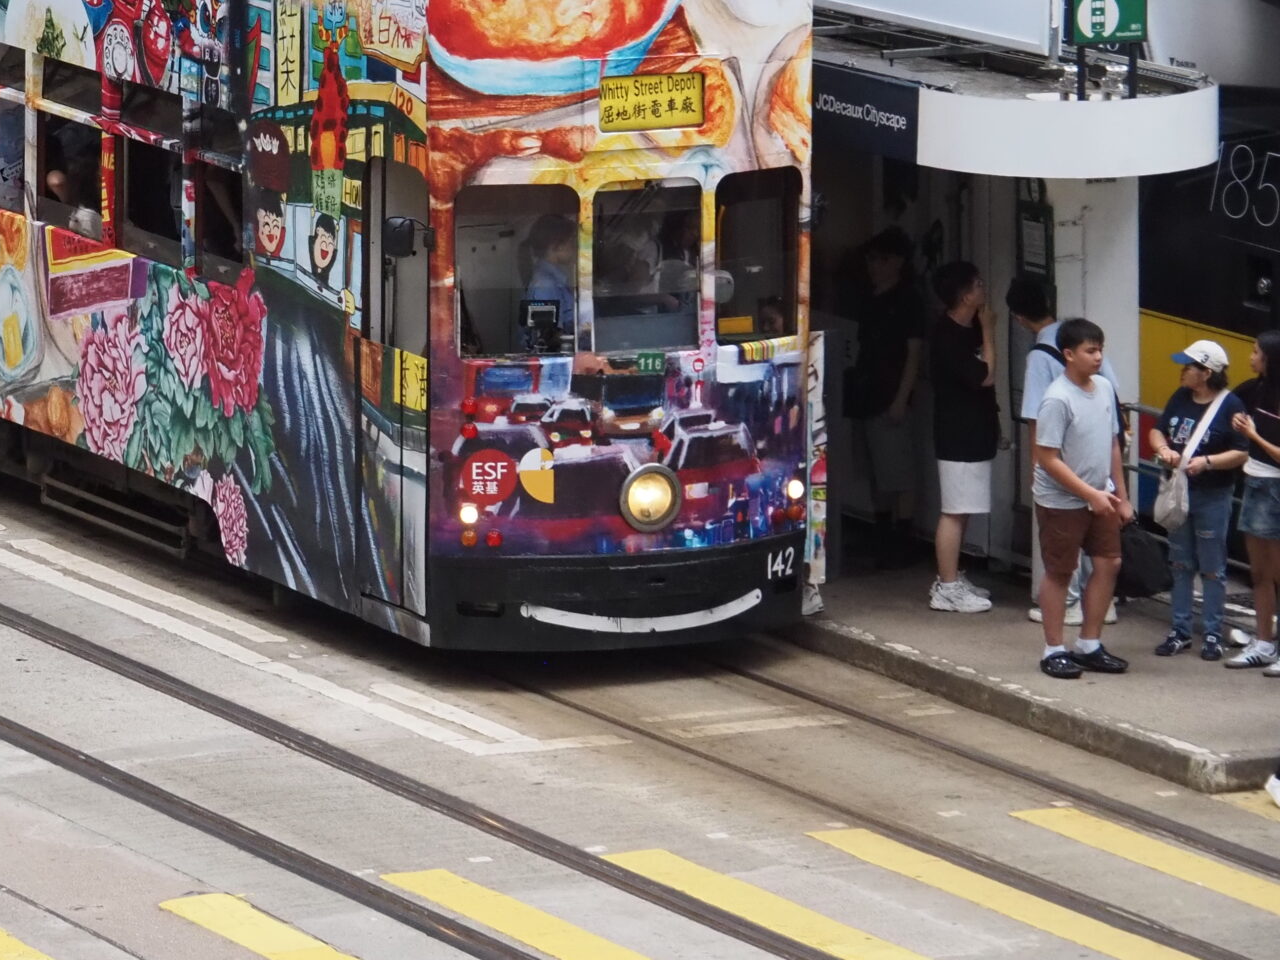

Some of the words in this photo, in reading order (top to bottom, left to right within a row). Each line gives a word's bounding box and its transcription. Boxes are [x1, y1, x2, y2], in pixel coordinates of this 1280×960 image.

[600, 83, 629, 102] Whitty
[633, 79, 663, 97] Street
[667, 74, 696, 94] Depot
[395, 92, 414, 116] 120
[600, 96, 697, 125] 屈地街電車廠
[816, 93, 863, 120] JCDecaux
[863, 103, 907, 131] Cityscape
[638, 356, 662, 370] 116
[472, 462, 508, 480] ESF
[471, 481, 499, 495] 英基
[767, 546, 795, 579] 142
